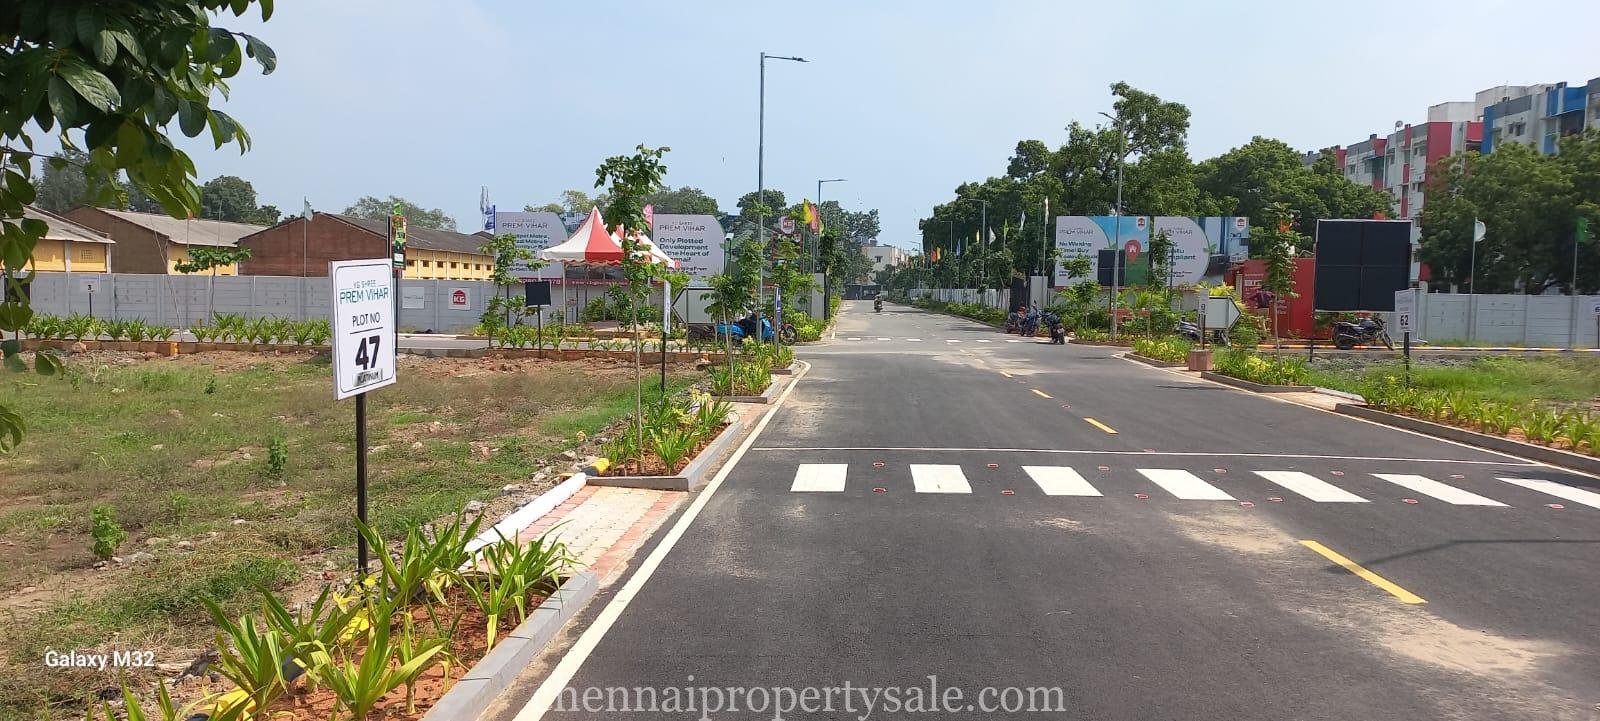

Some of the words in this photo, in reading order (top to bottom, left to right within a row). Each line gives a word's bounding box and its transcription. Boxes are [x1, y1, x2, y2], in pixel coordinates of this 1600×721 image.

[659, 224, 681, 232] PREM
[659, 243, 708, 251] Development
[339, 289, 364, 304] PREM
[365, 287, 389, 301] VIHAR
[453, 295, 465, 303] KG
[352, 313, 369, 327] PLOT
[370, 312, 381, 324] NO
[1400, 314, 1409, 326] 62
[355, 335, 381, 371] 47
